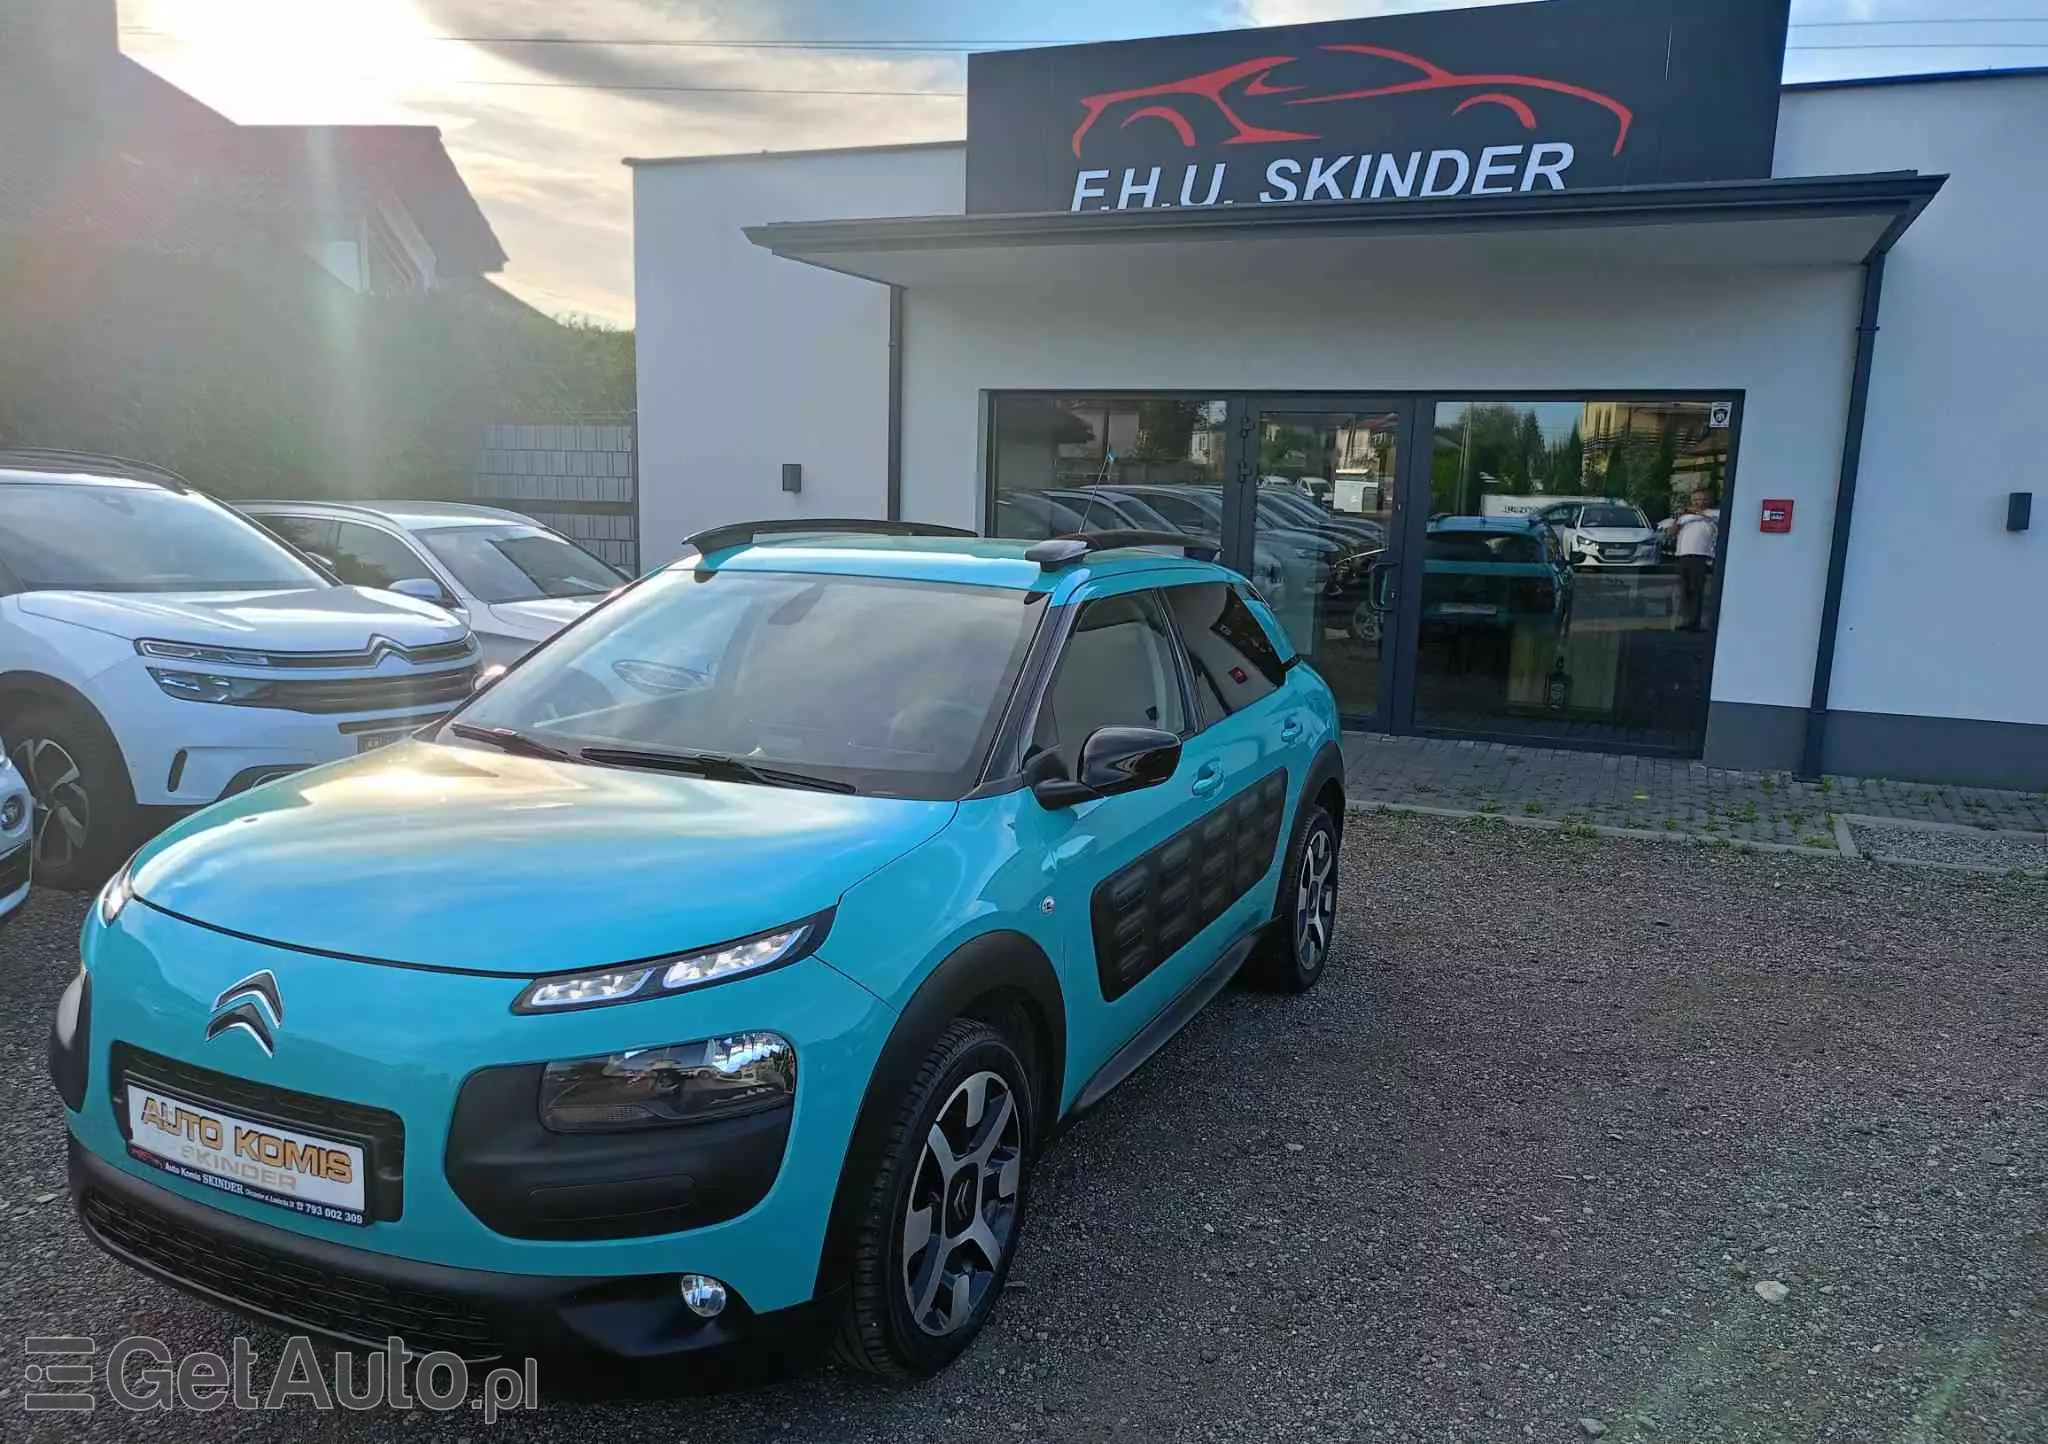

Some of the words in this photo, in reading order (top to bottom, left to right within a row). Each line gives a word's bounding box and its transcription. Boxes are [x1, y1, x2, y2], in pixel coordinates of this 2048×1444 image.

[1071, 162, 1233, 212] F.H.U.
[1259, 142, 1575, 203] SKINDER
[141, 1096, 223, 1150] AUTO
[234, 1126, 353, 1184] KOMIS
[181, 1145, 297, 1191] SKINDER
[202, 1173, 244, 1195] SKINDER
[305, 1203, 322, 1215] 793
[324, 1208, 343, 1220] 002
[344, 1212, 363, 1225] 309
